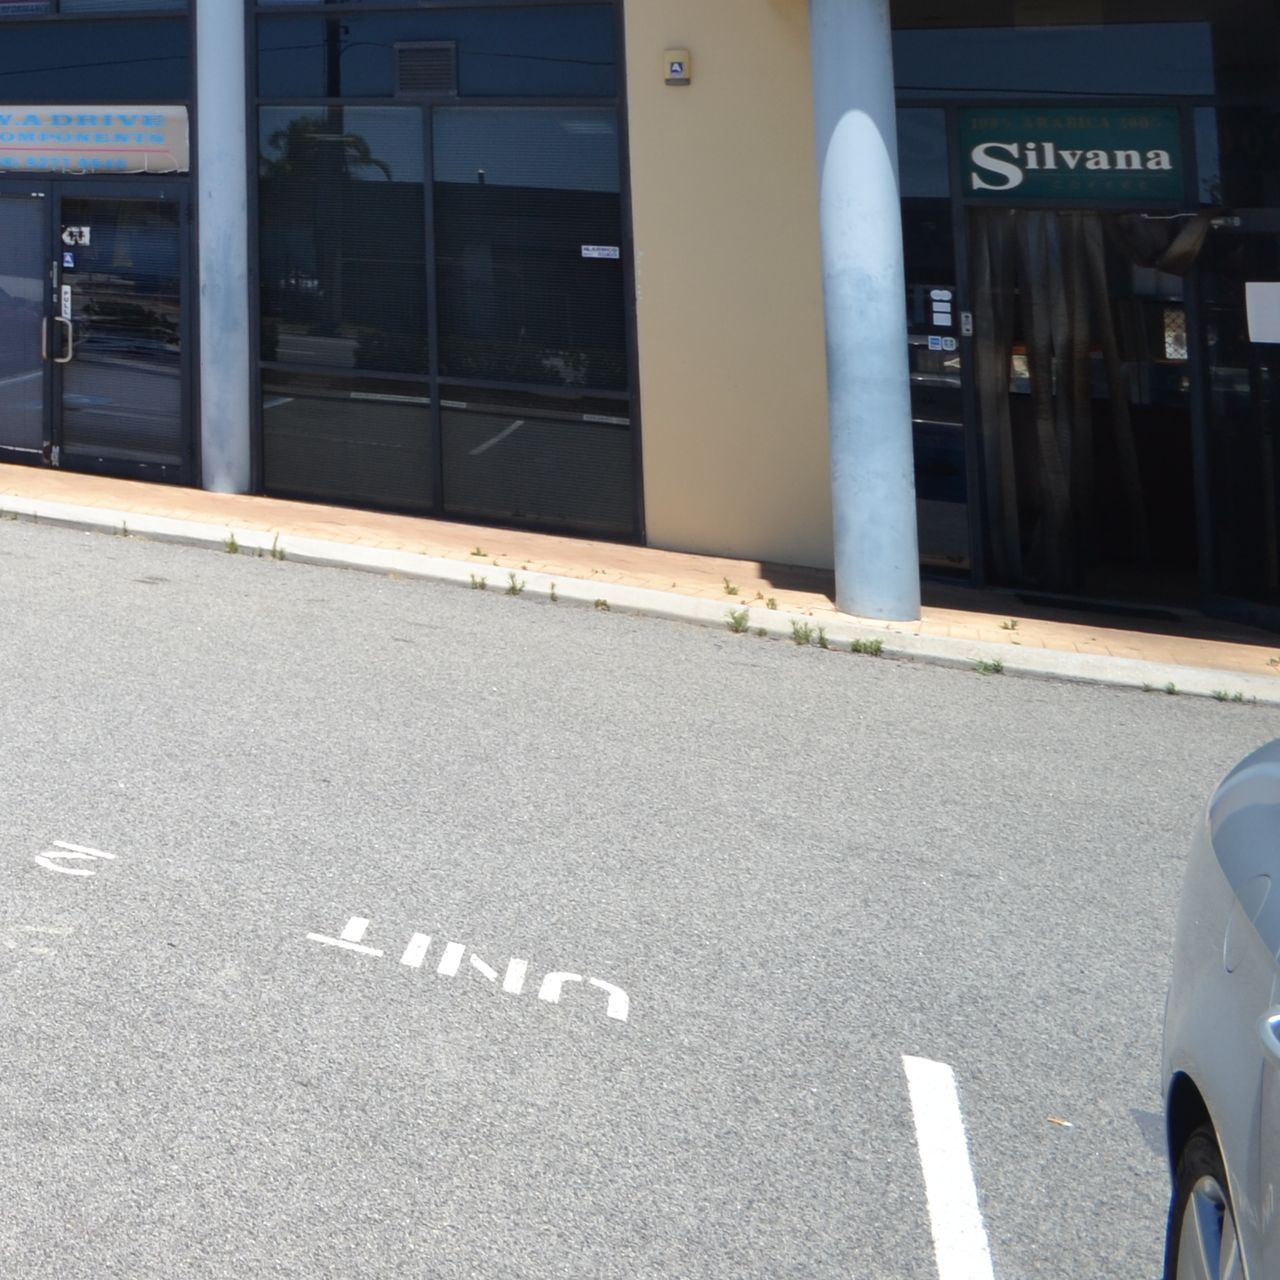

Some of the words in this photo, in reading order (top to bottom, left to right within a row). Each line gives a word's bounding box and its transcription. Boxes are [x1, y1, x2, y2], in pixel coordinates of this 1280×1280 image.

[50, 114, 166, 128] DRIVE
[970, 141, 1173, 191] Silvana
[306, 915, 630, 1021] UNIT
